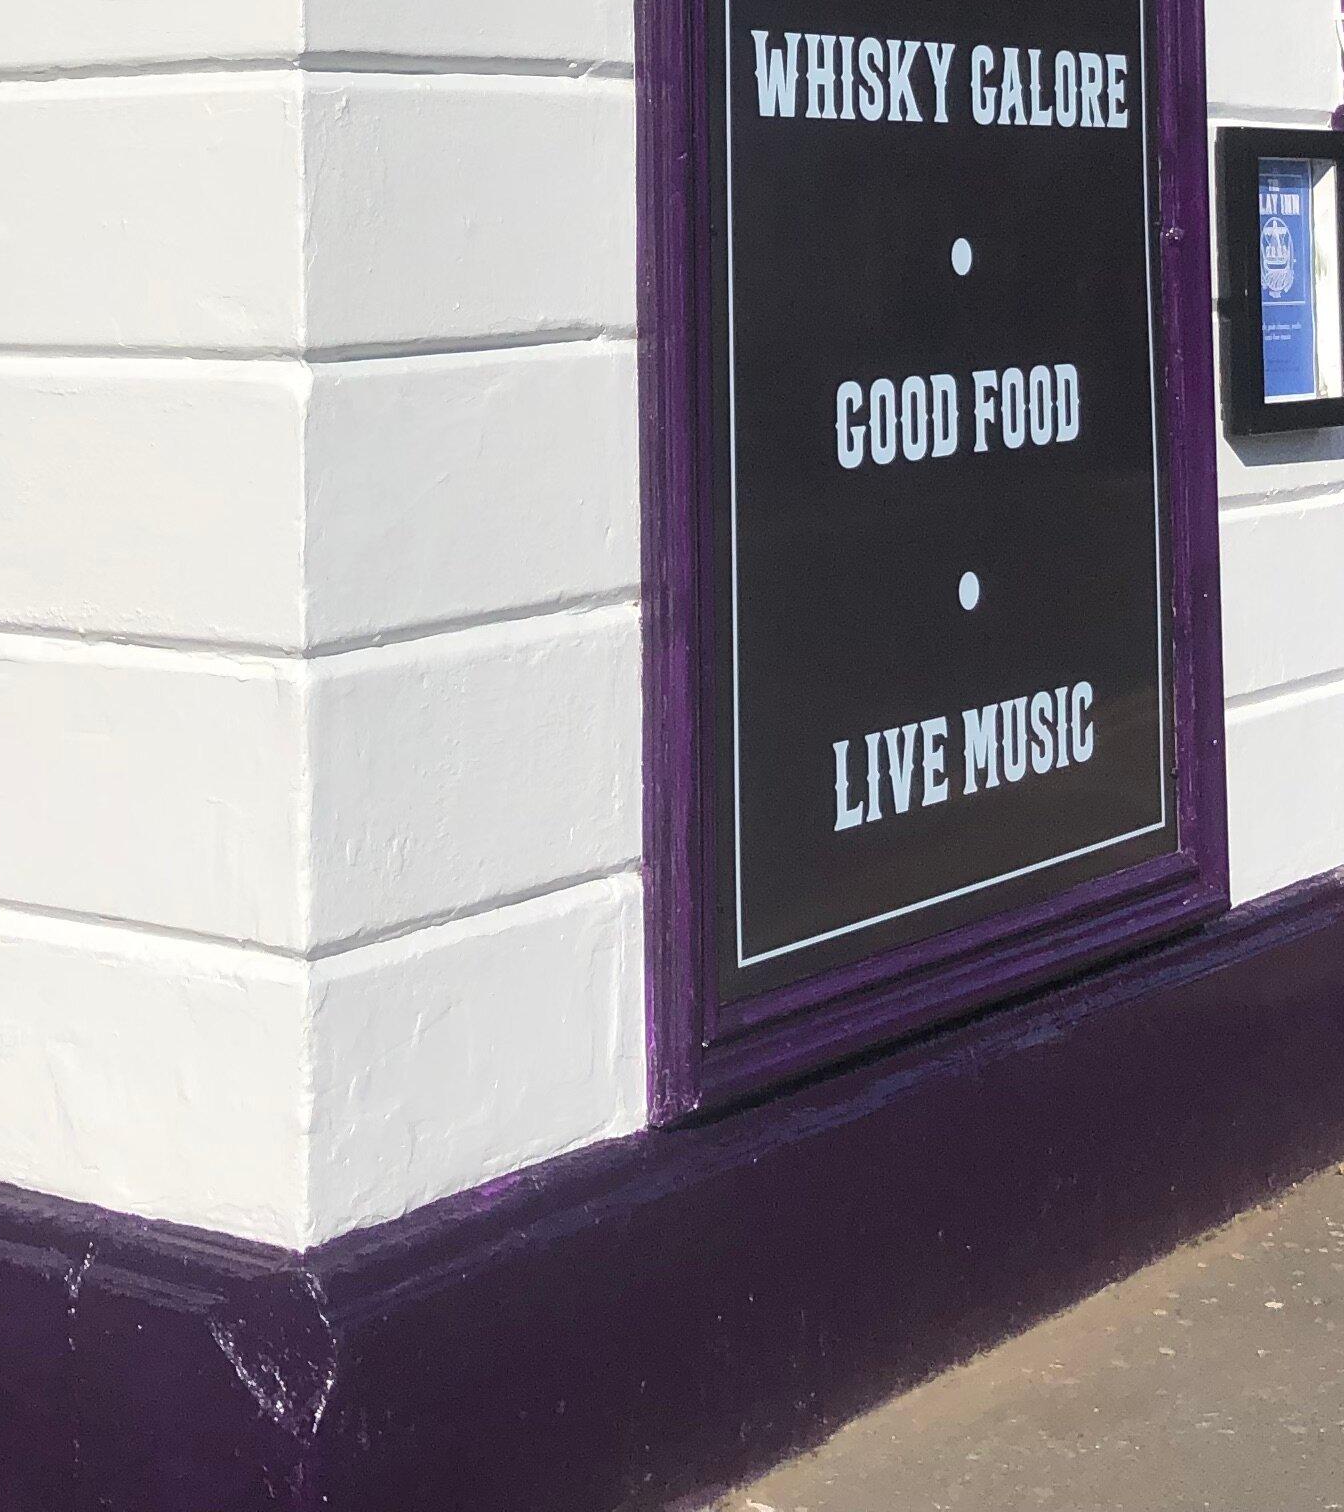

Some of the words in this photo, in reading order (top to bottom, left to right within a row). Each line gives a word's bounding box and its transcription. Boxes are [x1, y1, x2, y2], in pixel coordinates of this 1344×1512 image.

[751, 30, 955, 122] WHISKY
[971, 45, 1128, 128] GALORE
[835, 374, 959, 468] GOOD
[972, 364, 1079, 452] FOOD
[833, 716, 948, 831] LIVE
[962, 681, 1094, 795] MUSIC
